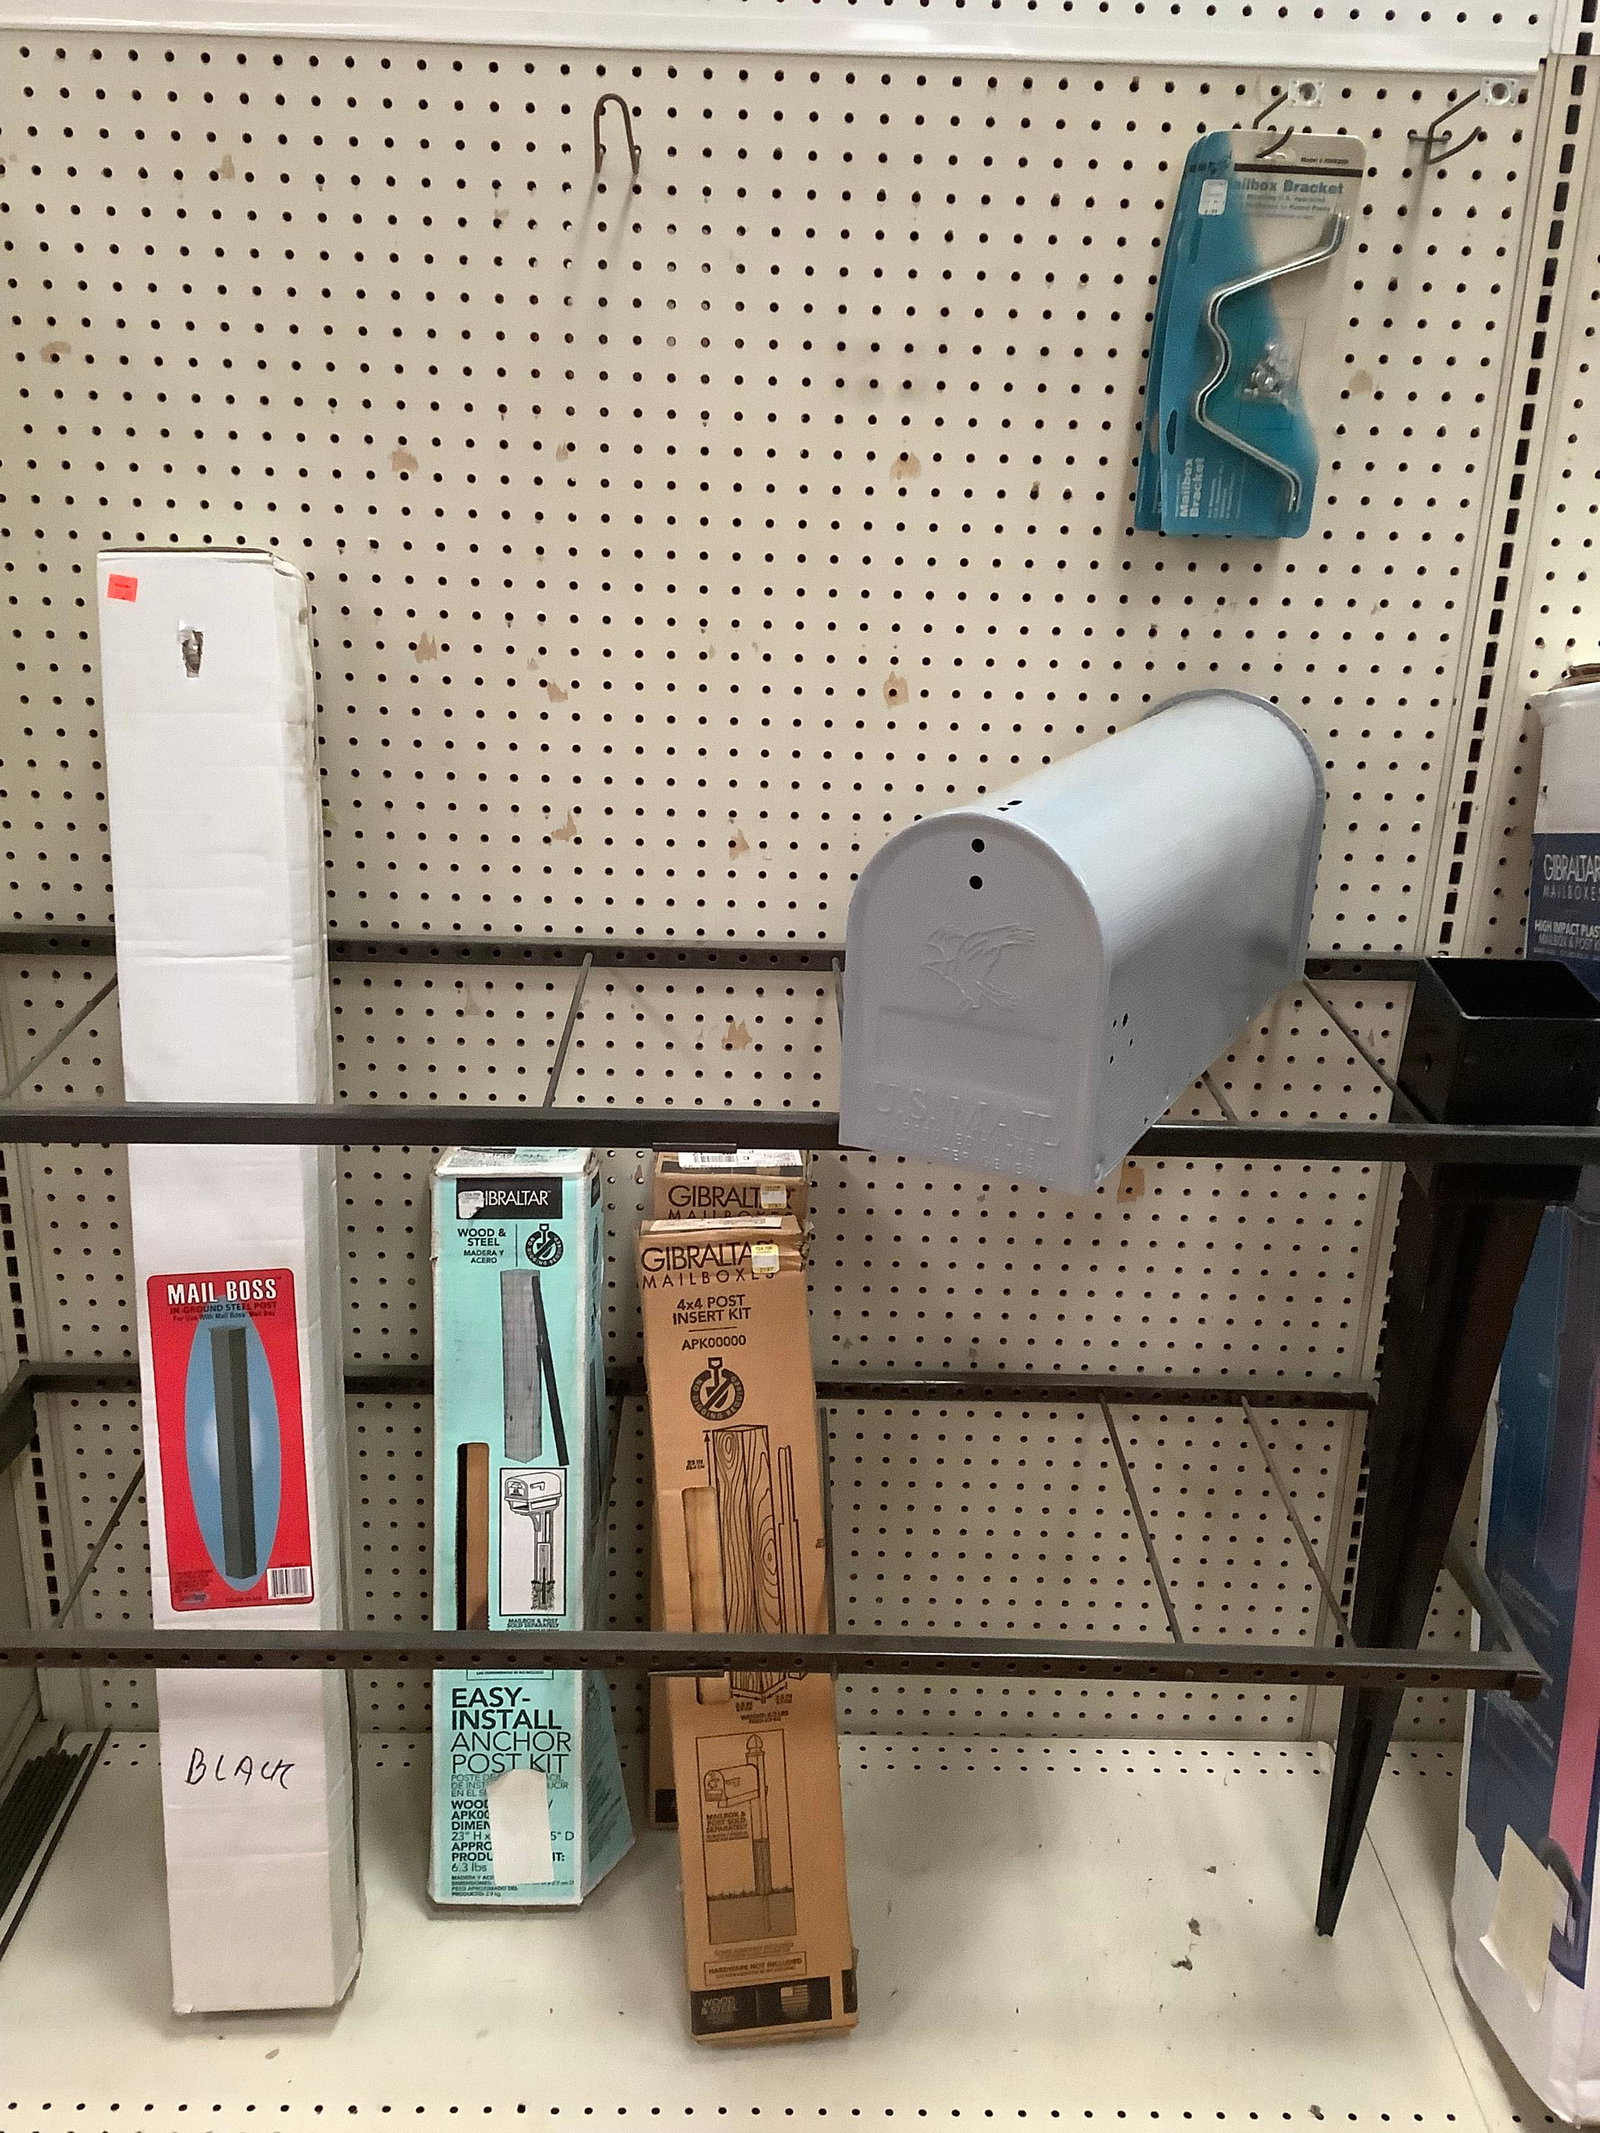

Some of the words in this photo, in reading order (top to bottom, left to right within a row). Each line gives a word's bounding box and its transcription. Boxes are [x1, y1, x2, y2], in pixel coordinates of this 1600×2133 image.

[1231, 178, 1277, 192] ailbox
[1284, 180, 1344, 194] Bracket
[1180, 458, 1194, 517] Mailbox
[1189, 457, 1205, 517] Bracket
[1542, 884, 1600, 901] MAILBOXE
[1581, 923, 1600, 939] PLAS
[485, 1189, 550, 1206] IBRALTAR
[668, 1184, 792, 1209] GIBRALT
[457, 1228, 495, 1237] WOOD
[498, 1228, 506, 1237] &
[468, 1237, 500, 1247] STEEL
[167, 1281, 219, 1305] MAIL
[225, 1278, 277, 1302] BOSS
[225, 1303, 252, 1313] STEEL
[254, 1301, 277, 1311] POST
[677, 1298, 703, 1310] 4x4
[707, 1294, 746, 1309] POST
[672, 1309, 725, 1325] INSERT
[728, 1307, 752, 1320] KIT
[681, 1335, 747, 1351] APK00000
[452, 1686, 531, 1708] EASY-
[452, 1709, 562, 1730] INSTALL
[450, 1731, 571, 1752] ANCHOR
[184, 1747, 295, 1790] BLACK
[452, 1753, 522, 1774] POST
[530, 1753, 569, 1774] KIT
[451, 1774, 481, 1782] POSTE
[547, 1781, 568, 1789] UCIR
[450, 1810, 490, 1820] APK00
[451, 1821, 491, 1831] DIMEN
[473, 1831, 482, 1840] H
[565, 1831, 575, 1840] D
[451, 1841, 493, 1851] APPRO
[451, 1852, 494, 1861] PRODU
[451, 1863, 469, 1872] 6.3
[470, 1862, 488, 1872] lbs
